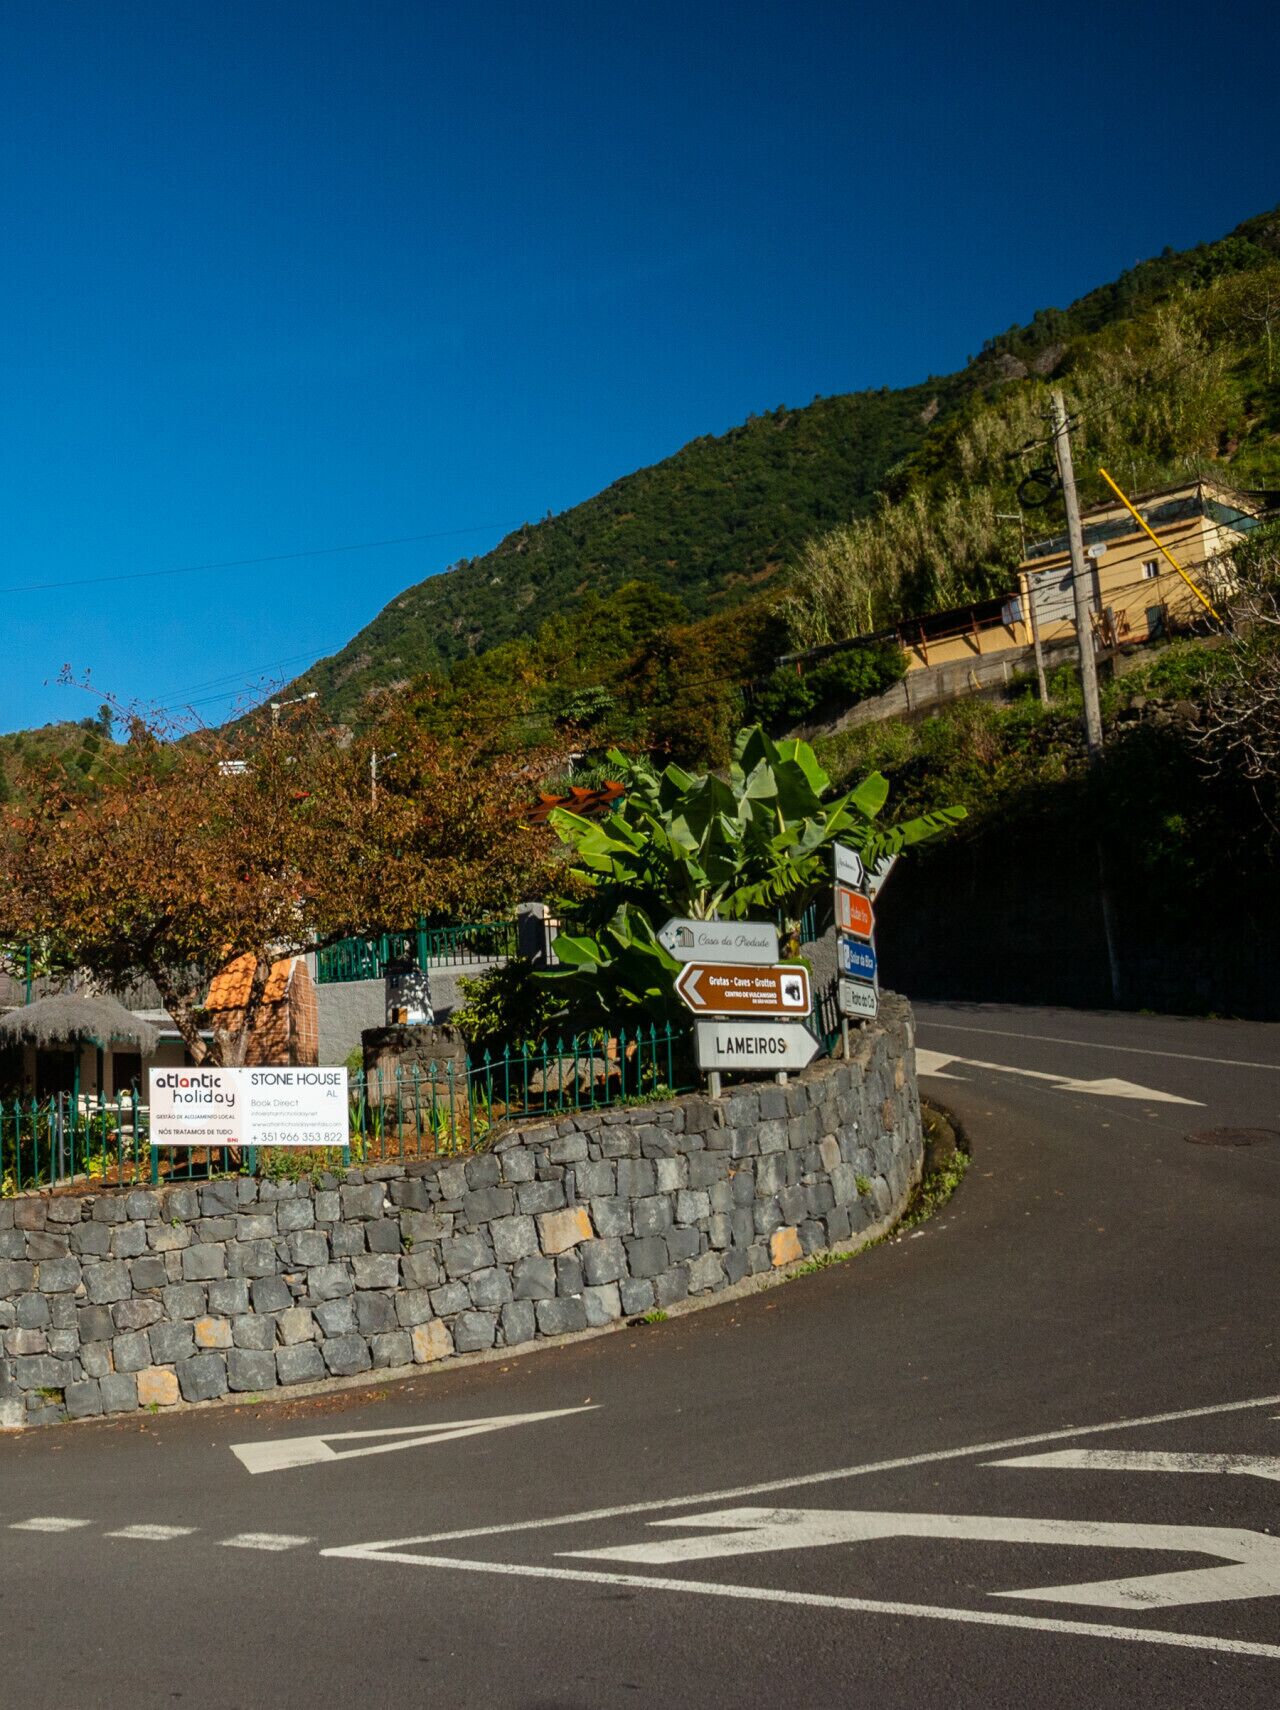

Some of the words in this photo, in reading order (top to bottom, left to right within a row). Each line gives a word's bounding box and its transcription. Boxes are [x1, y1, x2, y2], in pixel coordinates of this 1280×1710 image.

[698, 933, 719, 945] Casa
[721, 936, 732, 945] da
[735, 935, 769, 948] Piedade
[709, 975, 729, 987] Grutas
[733, 976, 751, 987] Caves
[754, 977, 776, 988] Grotten
[716, 1036, 786, 1054] LAMEIROS
[156, 1073, 221, 1088] atlantic
[251, 1073, 293, 1085] STONE
[297, 1073, 341, 1085] HOUSE
[173, 1089, 235, 1107] holiday
[251, 1099, 271, 1107] Book
[273, 1099, 299, 1107] Direct
[261, 1132, 277, 1141] 351
[279, 1132, 300, 1141] 966
[302, 1132, 321, 1141] 353
[323, 1132, 343, 1141] 822
